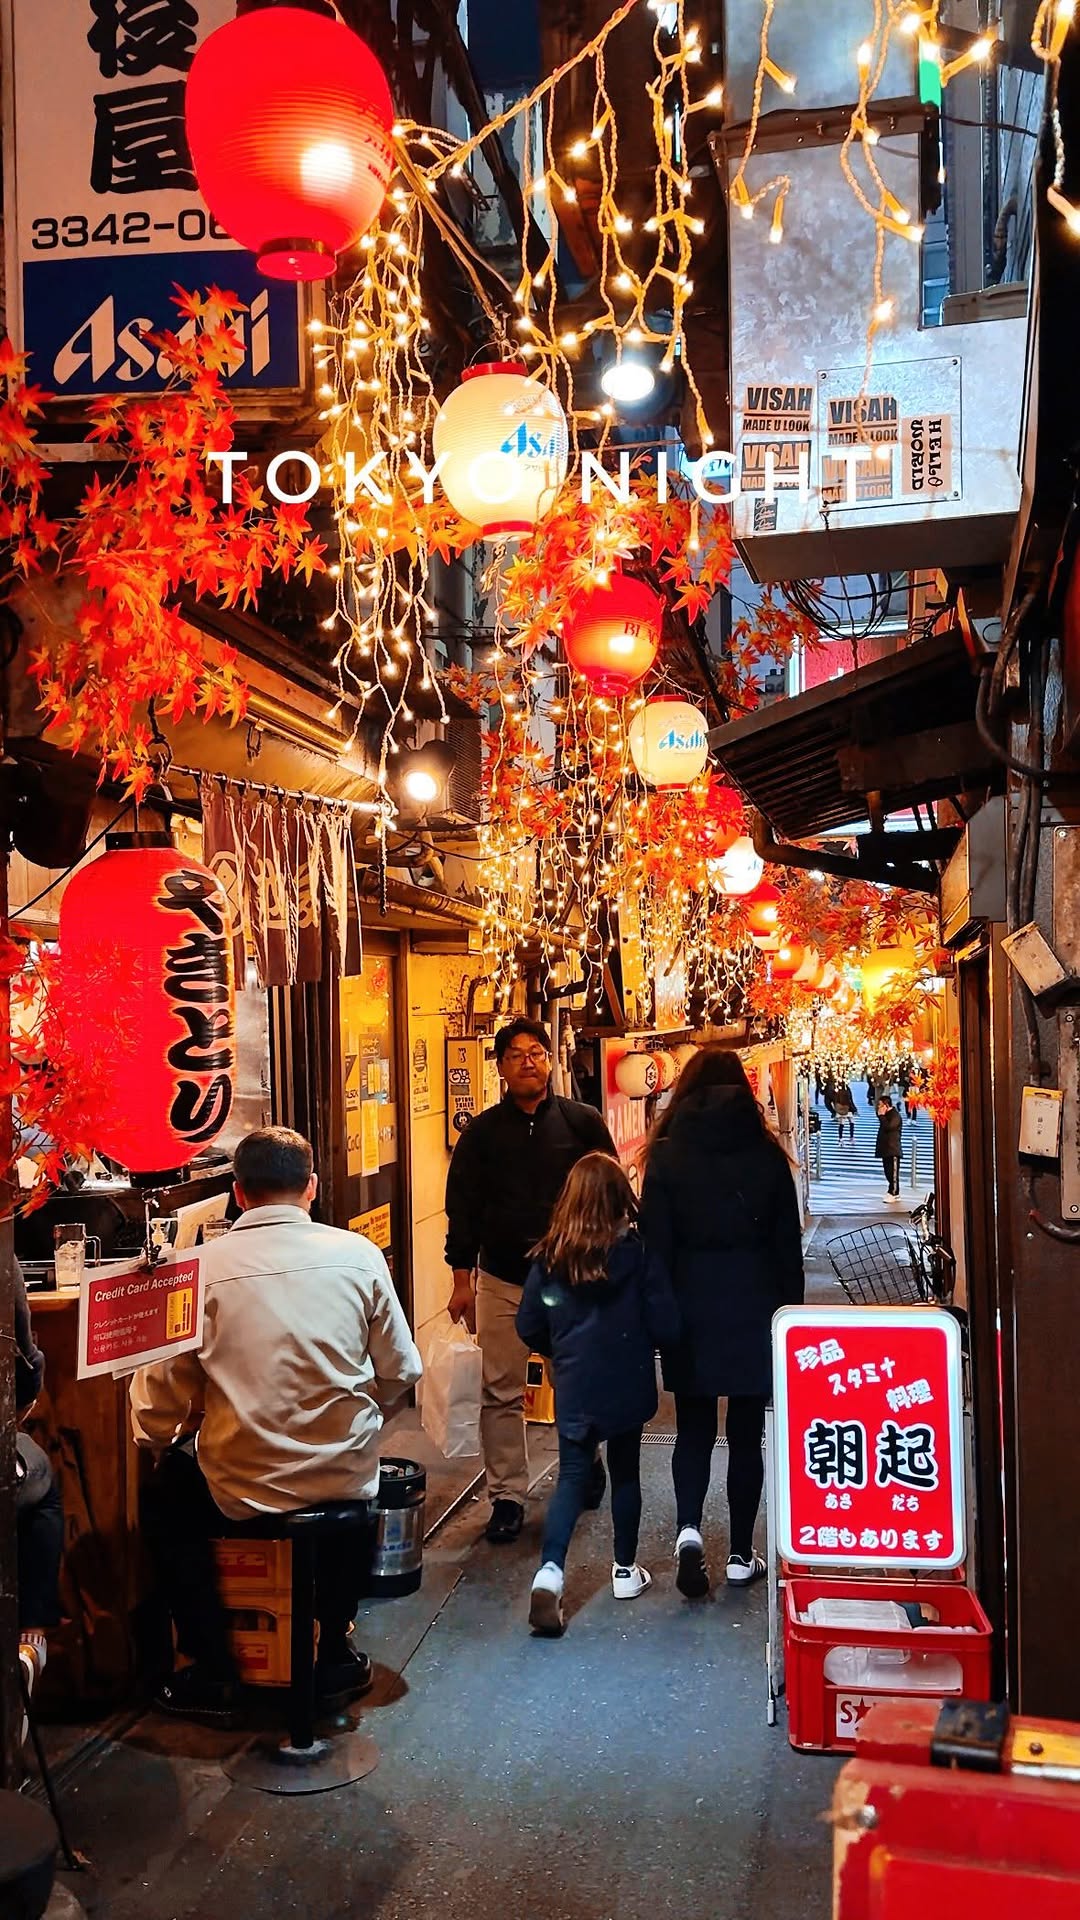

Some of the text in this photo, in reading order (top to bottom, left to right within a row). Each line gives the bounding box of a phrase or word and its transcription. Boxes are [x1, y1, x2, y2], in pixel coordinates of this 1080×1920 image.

[747, 387, 813, 412] VISAH
[830, 397, 897, 425] VISAH
[743, 419, 811, 432] MADE U LOOK
[828, 433, 858, 446] MADE
[870, 429, 898, 442] LOOK
[910, 419, 925, 491] WORLD
[927, 418, 944, 487] HELLO
[94, 1270, 194, 1302] Credit Card Accepted
[795, 1338, 846, 1371] 珍品
[828, 1356, 896, 1396] スタミナ
[886, 1378, 935, 1413] 料理
[805, 1418, 938, 1491] 朝起
[824, 1493, 920, 1512] あさ だち
[799, 1525, 944, 1551] 2階もあります
